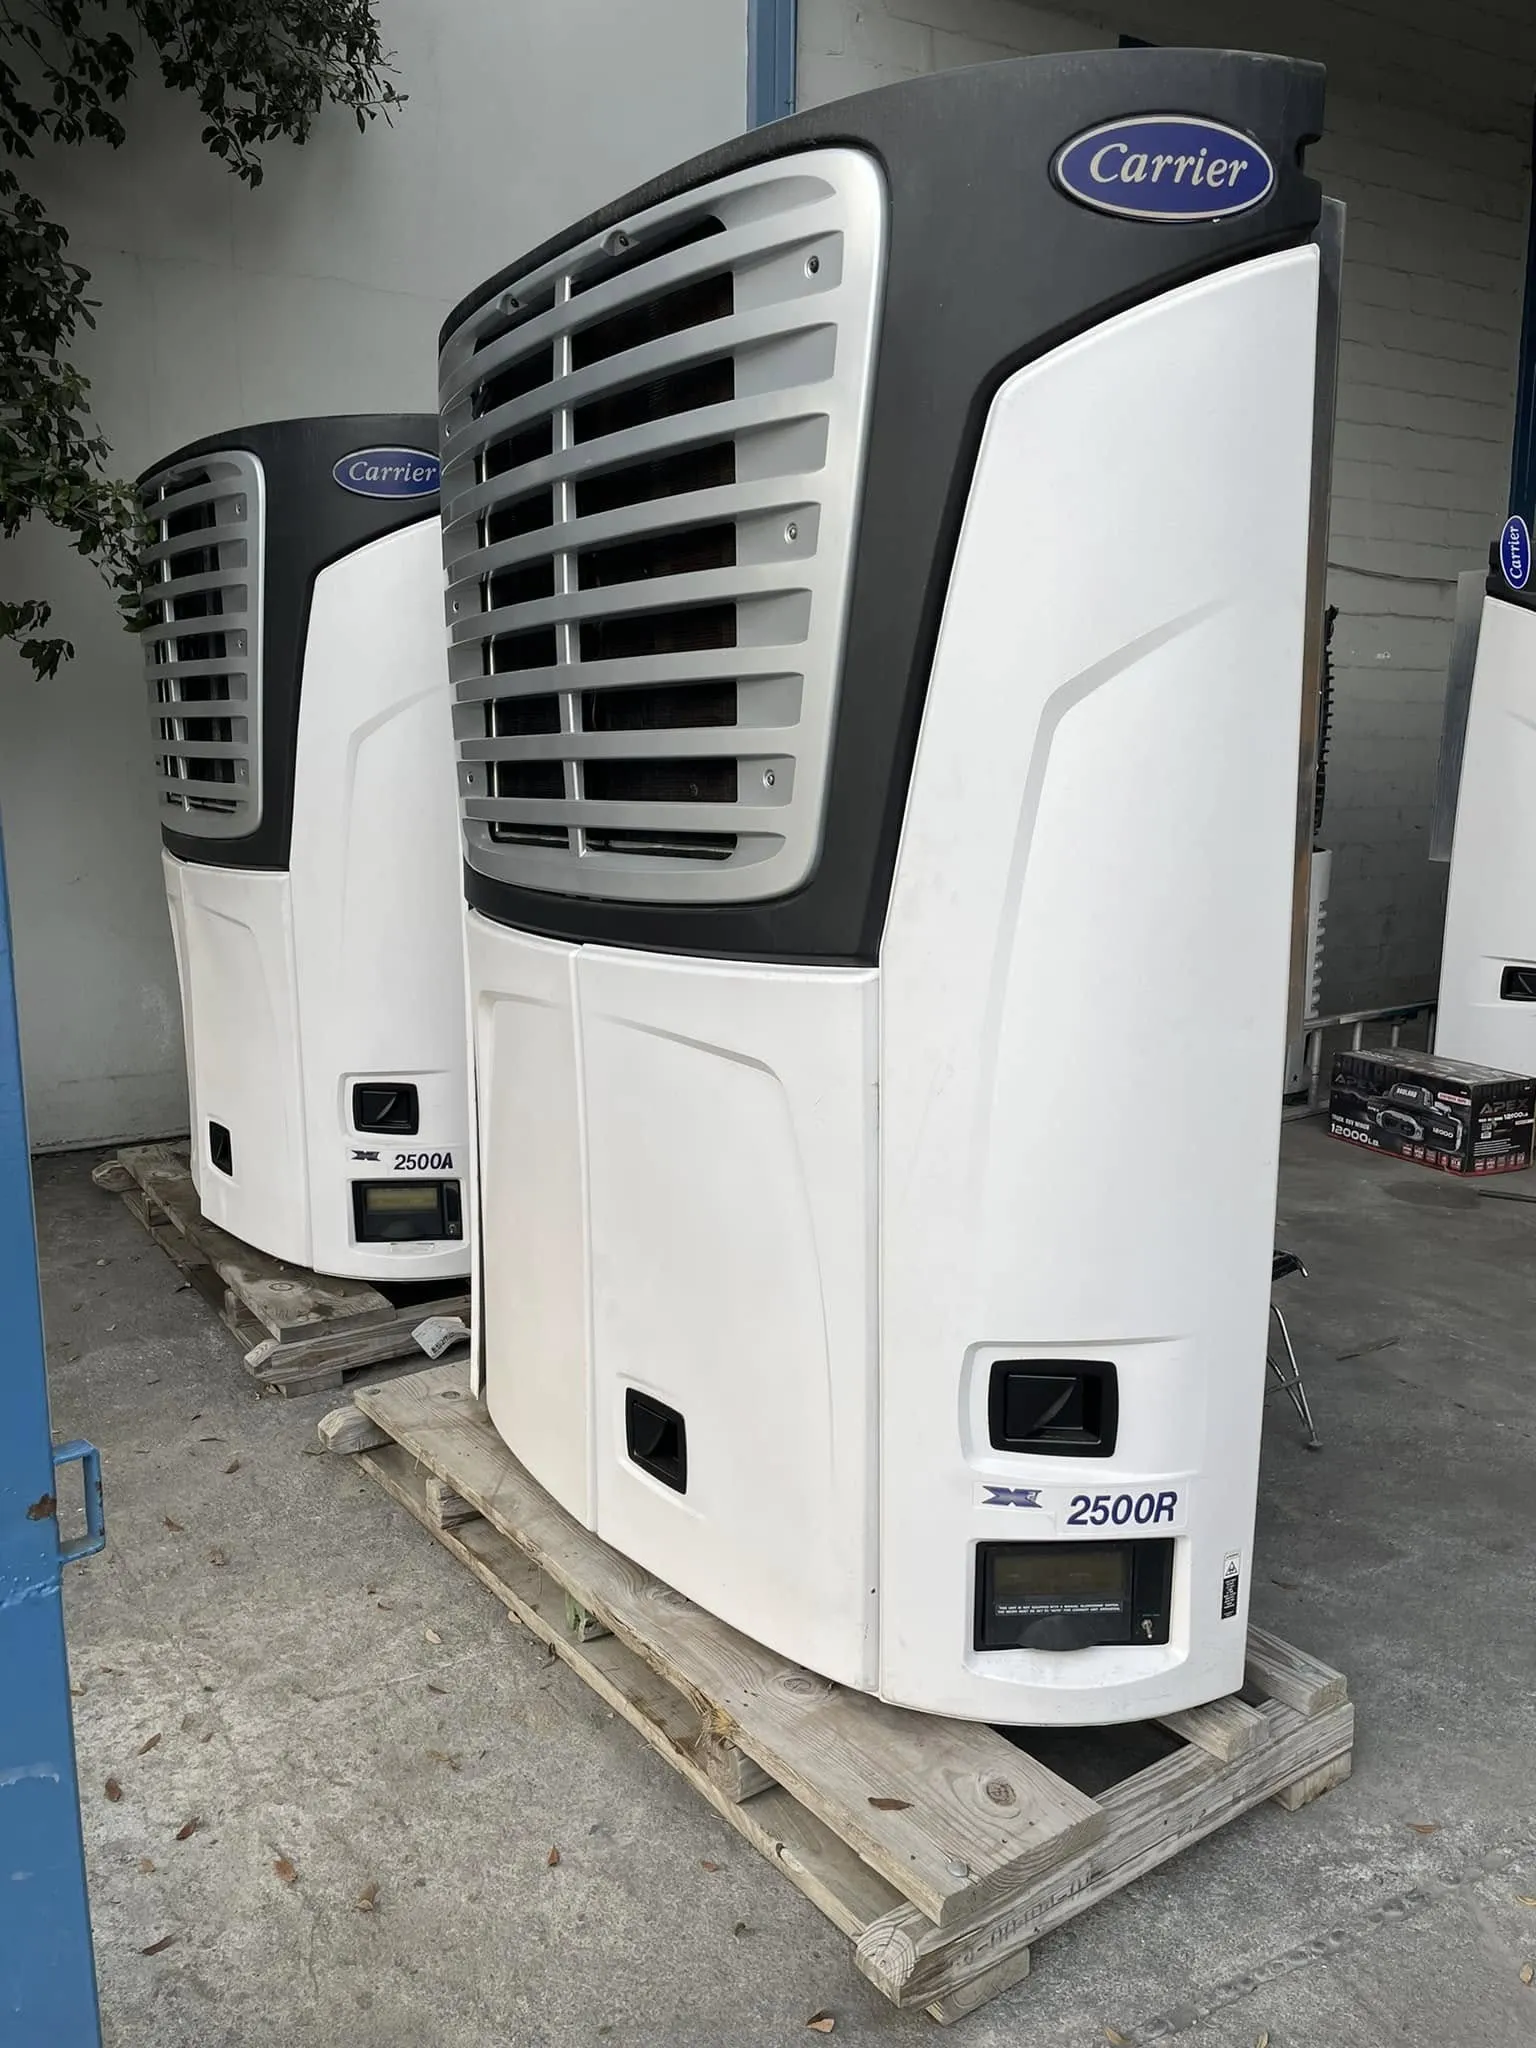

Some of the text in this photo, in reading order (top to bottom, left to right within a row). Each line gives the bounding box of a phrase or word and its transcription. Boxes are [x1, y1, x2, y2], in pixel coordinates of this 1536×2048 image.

[1089, 142, 1248, 188] Carrier
[348, 460, 437, 482] Carrier
[1508, 525, 1523, 579] Carrier
[393, 1152, 454, 1170] 2500A
[1066, 1490, 1178, 1526] 2500R
